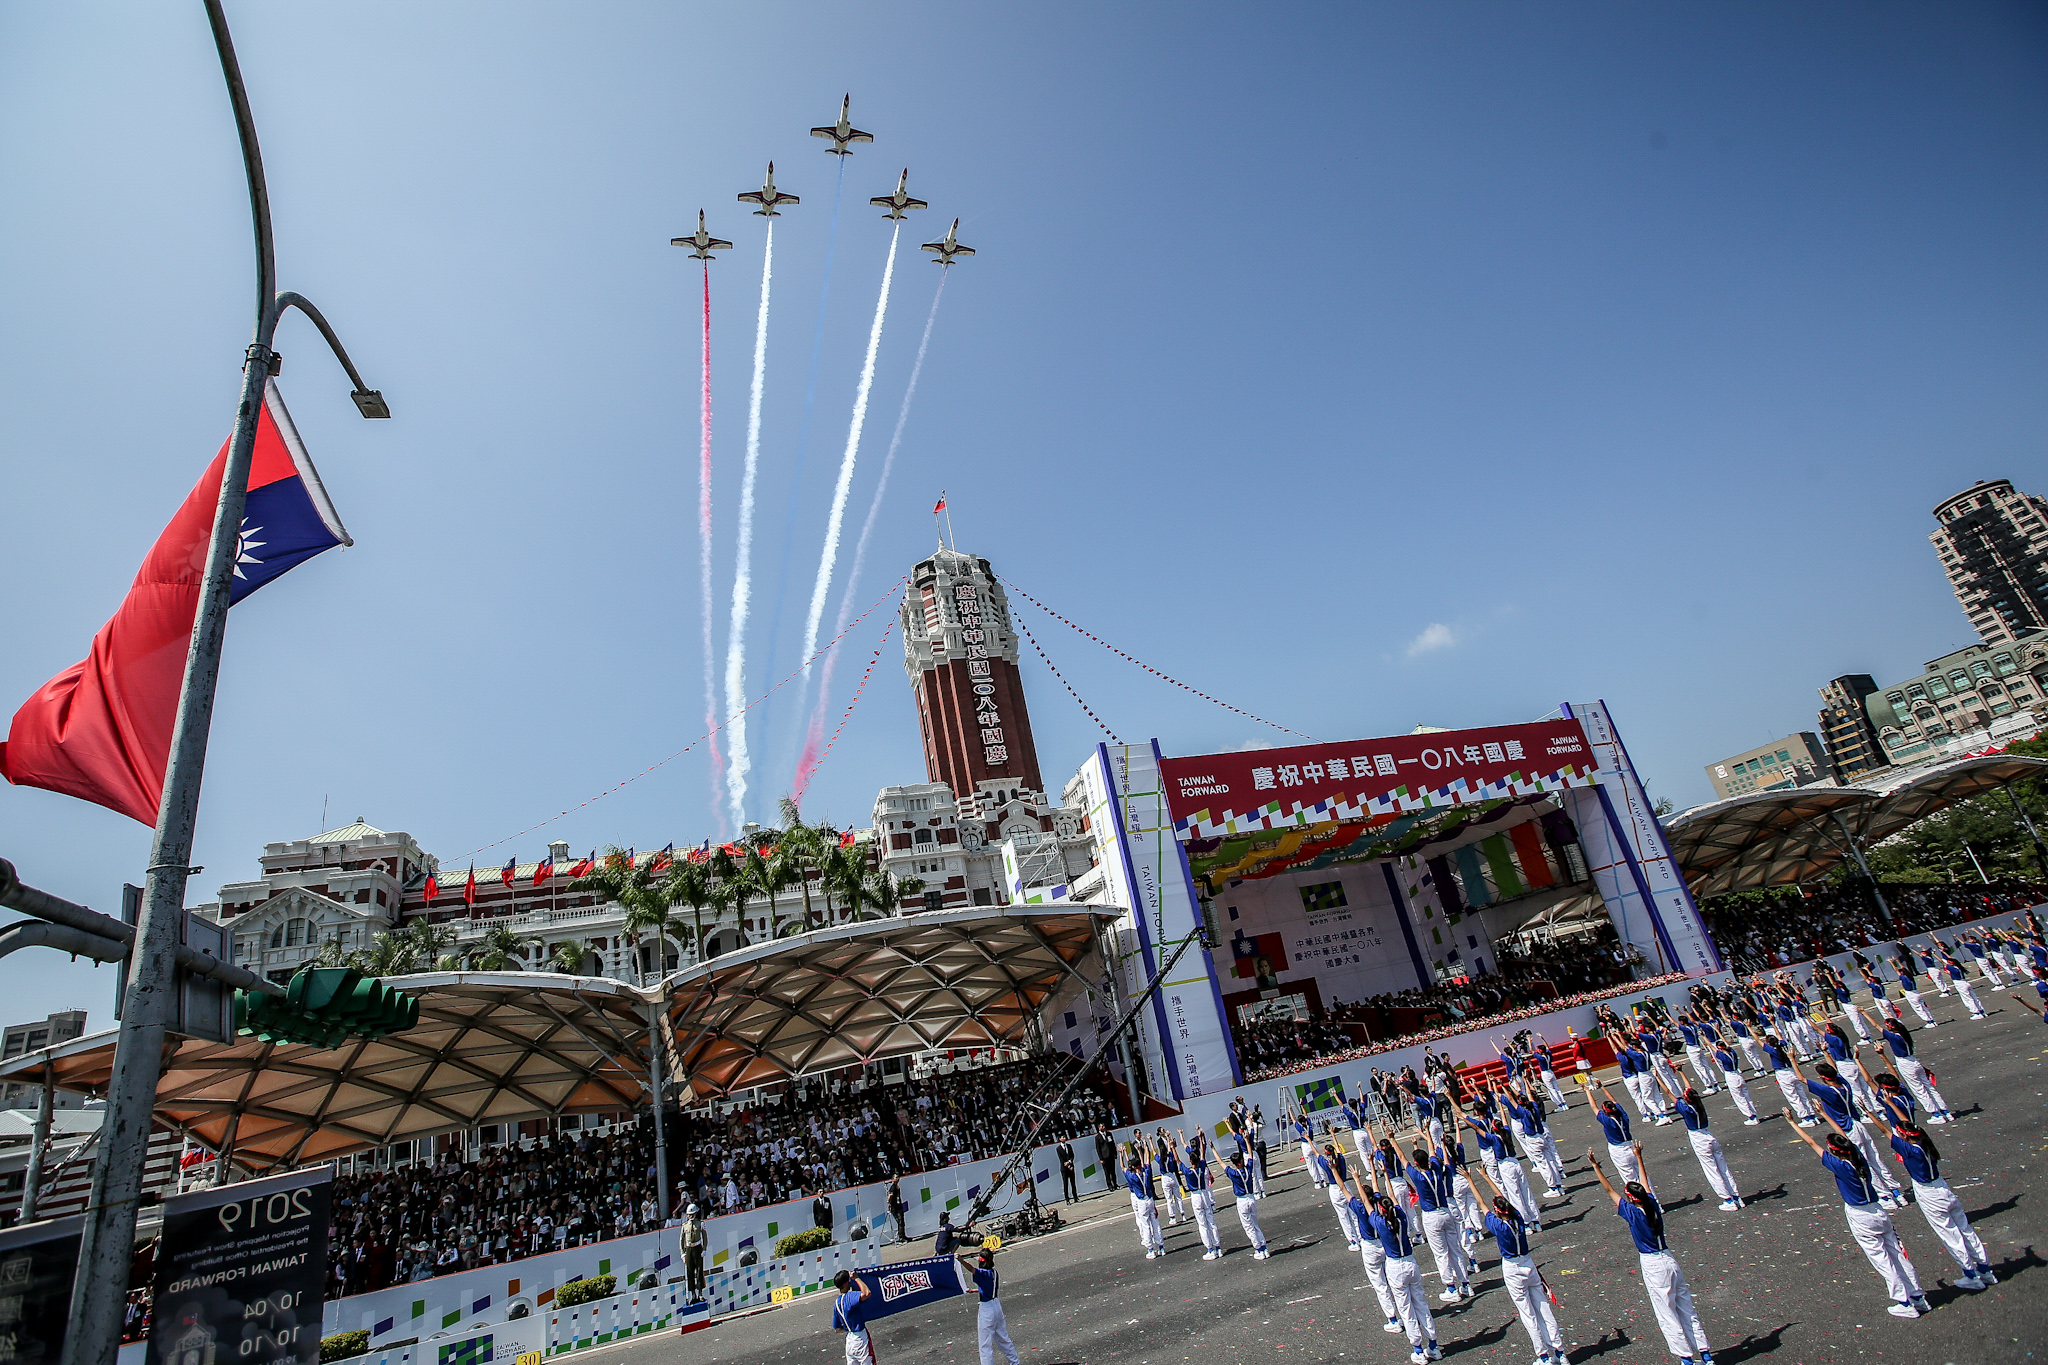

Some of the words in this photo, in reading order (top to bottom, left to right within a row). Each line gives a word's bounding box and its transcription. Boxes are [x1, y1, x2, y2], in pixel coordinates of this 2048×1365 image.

[1550, 735, 1579, 745] TAIWAN
[1546, 744, 1583, 756] FORWARD
[1252, 740, 1527, 790] 慶祝中華民國一〇八年國慶
[1177, 775, 1216, 787] TAIWAN
[1181, 784, 1230, 798] FORWARD
[1629, 797, 1648, 832] TAIWAN
[1646, 832, 1669, 880] FORWARD
[1141, 864, 1158, 909] TAIWAN
[1153, 912, 1171, 964] FORWAR
[1325, 954, 1360, 969] 國慶大會
[775, 1288, 790, 1302] 25
[496, 1340, 519, 1350] TAIWAN
[496, 1344, 526, 1355] FORWARD
[520, 1353, 536, 1365] 30
